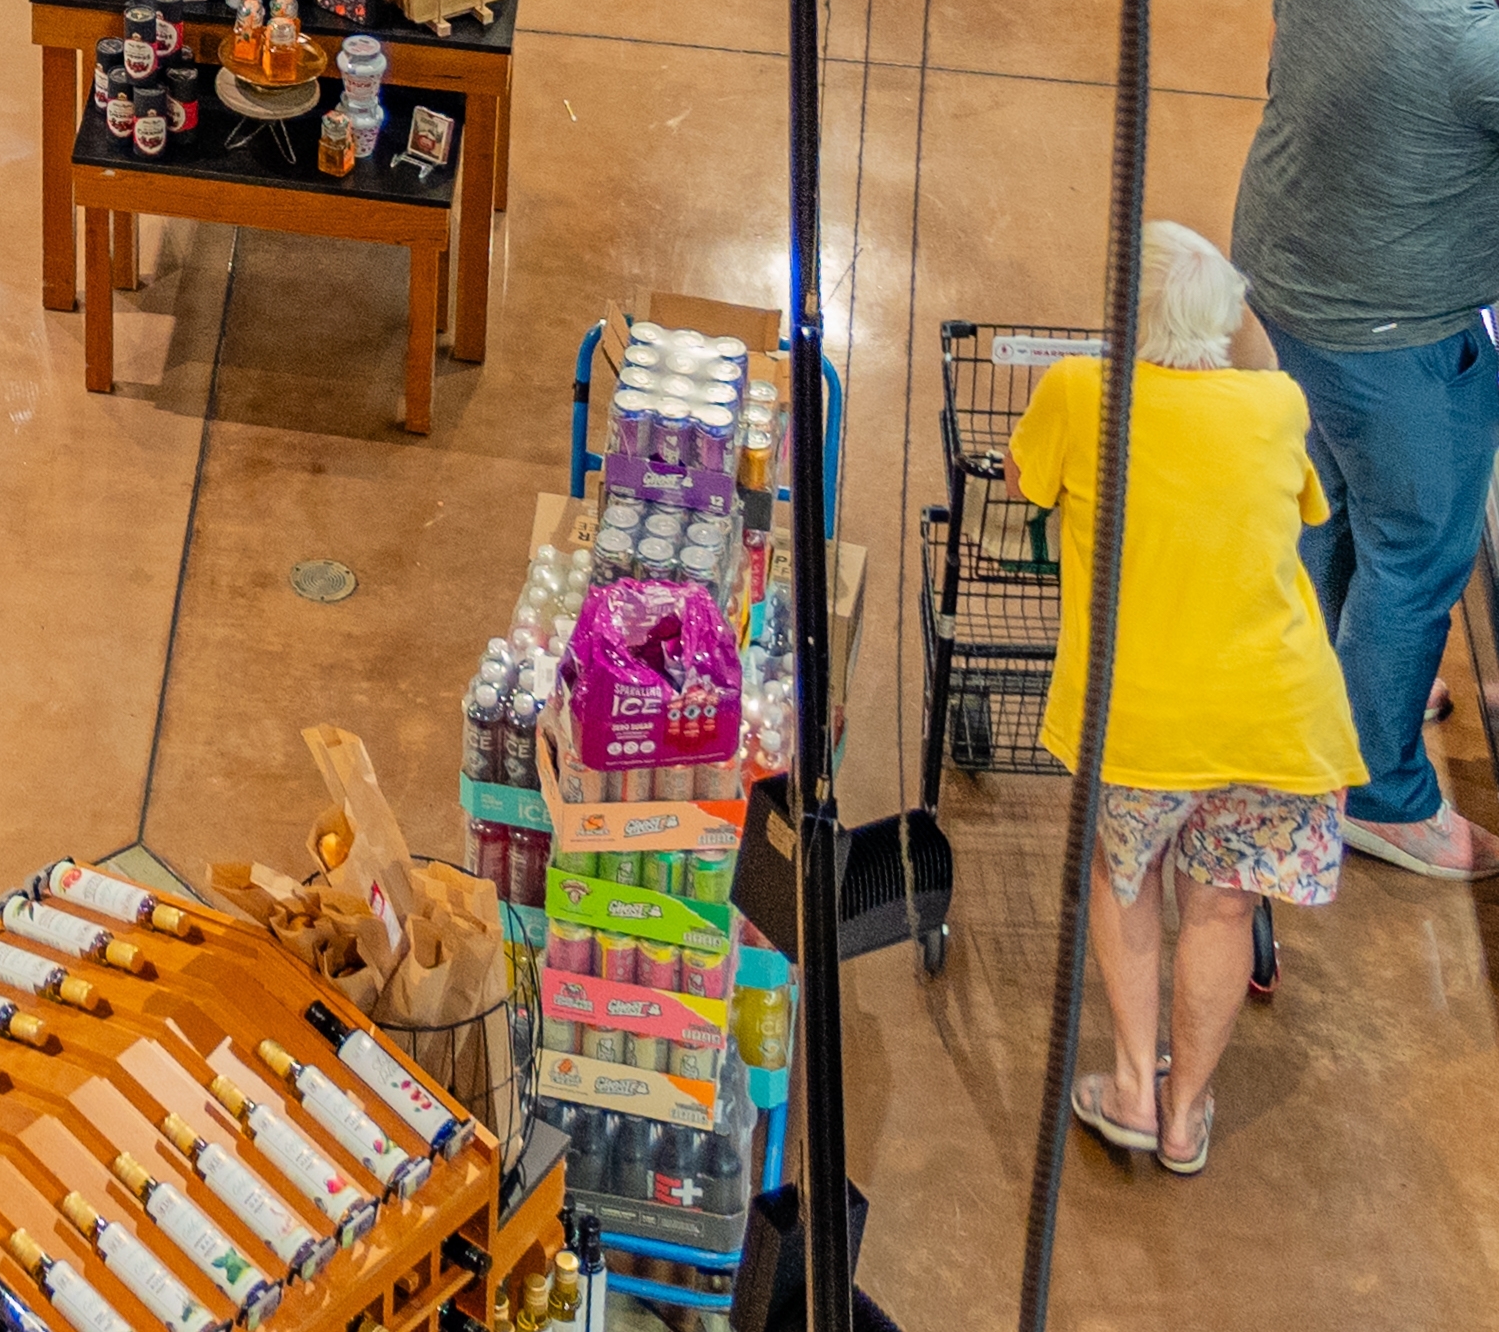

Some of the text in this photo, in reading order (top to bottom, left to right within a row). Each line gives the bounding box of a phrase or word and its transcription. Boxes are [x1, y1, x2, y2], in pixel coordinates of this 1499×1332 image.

[709, 494, 725, 506] 12
[614, 683, 661, 698] SPARKLING
[611, 695, 662, 716] ICE
